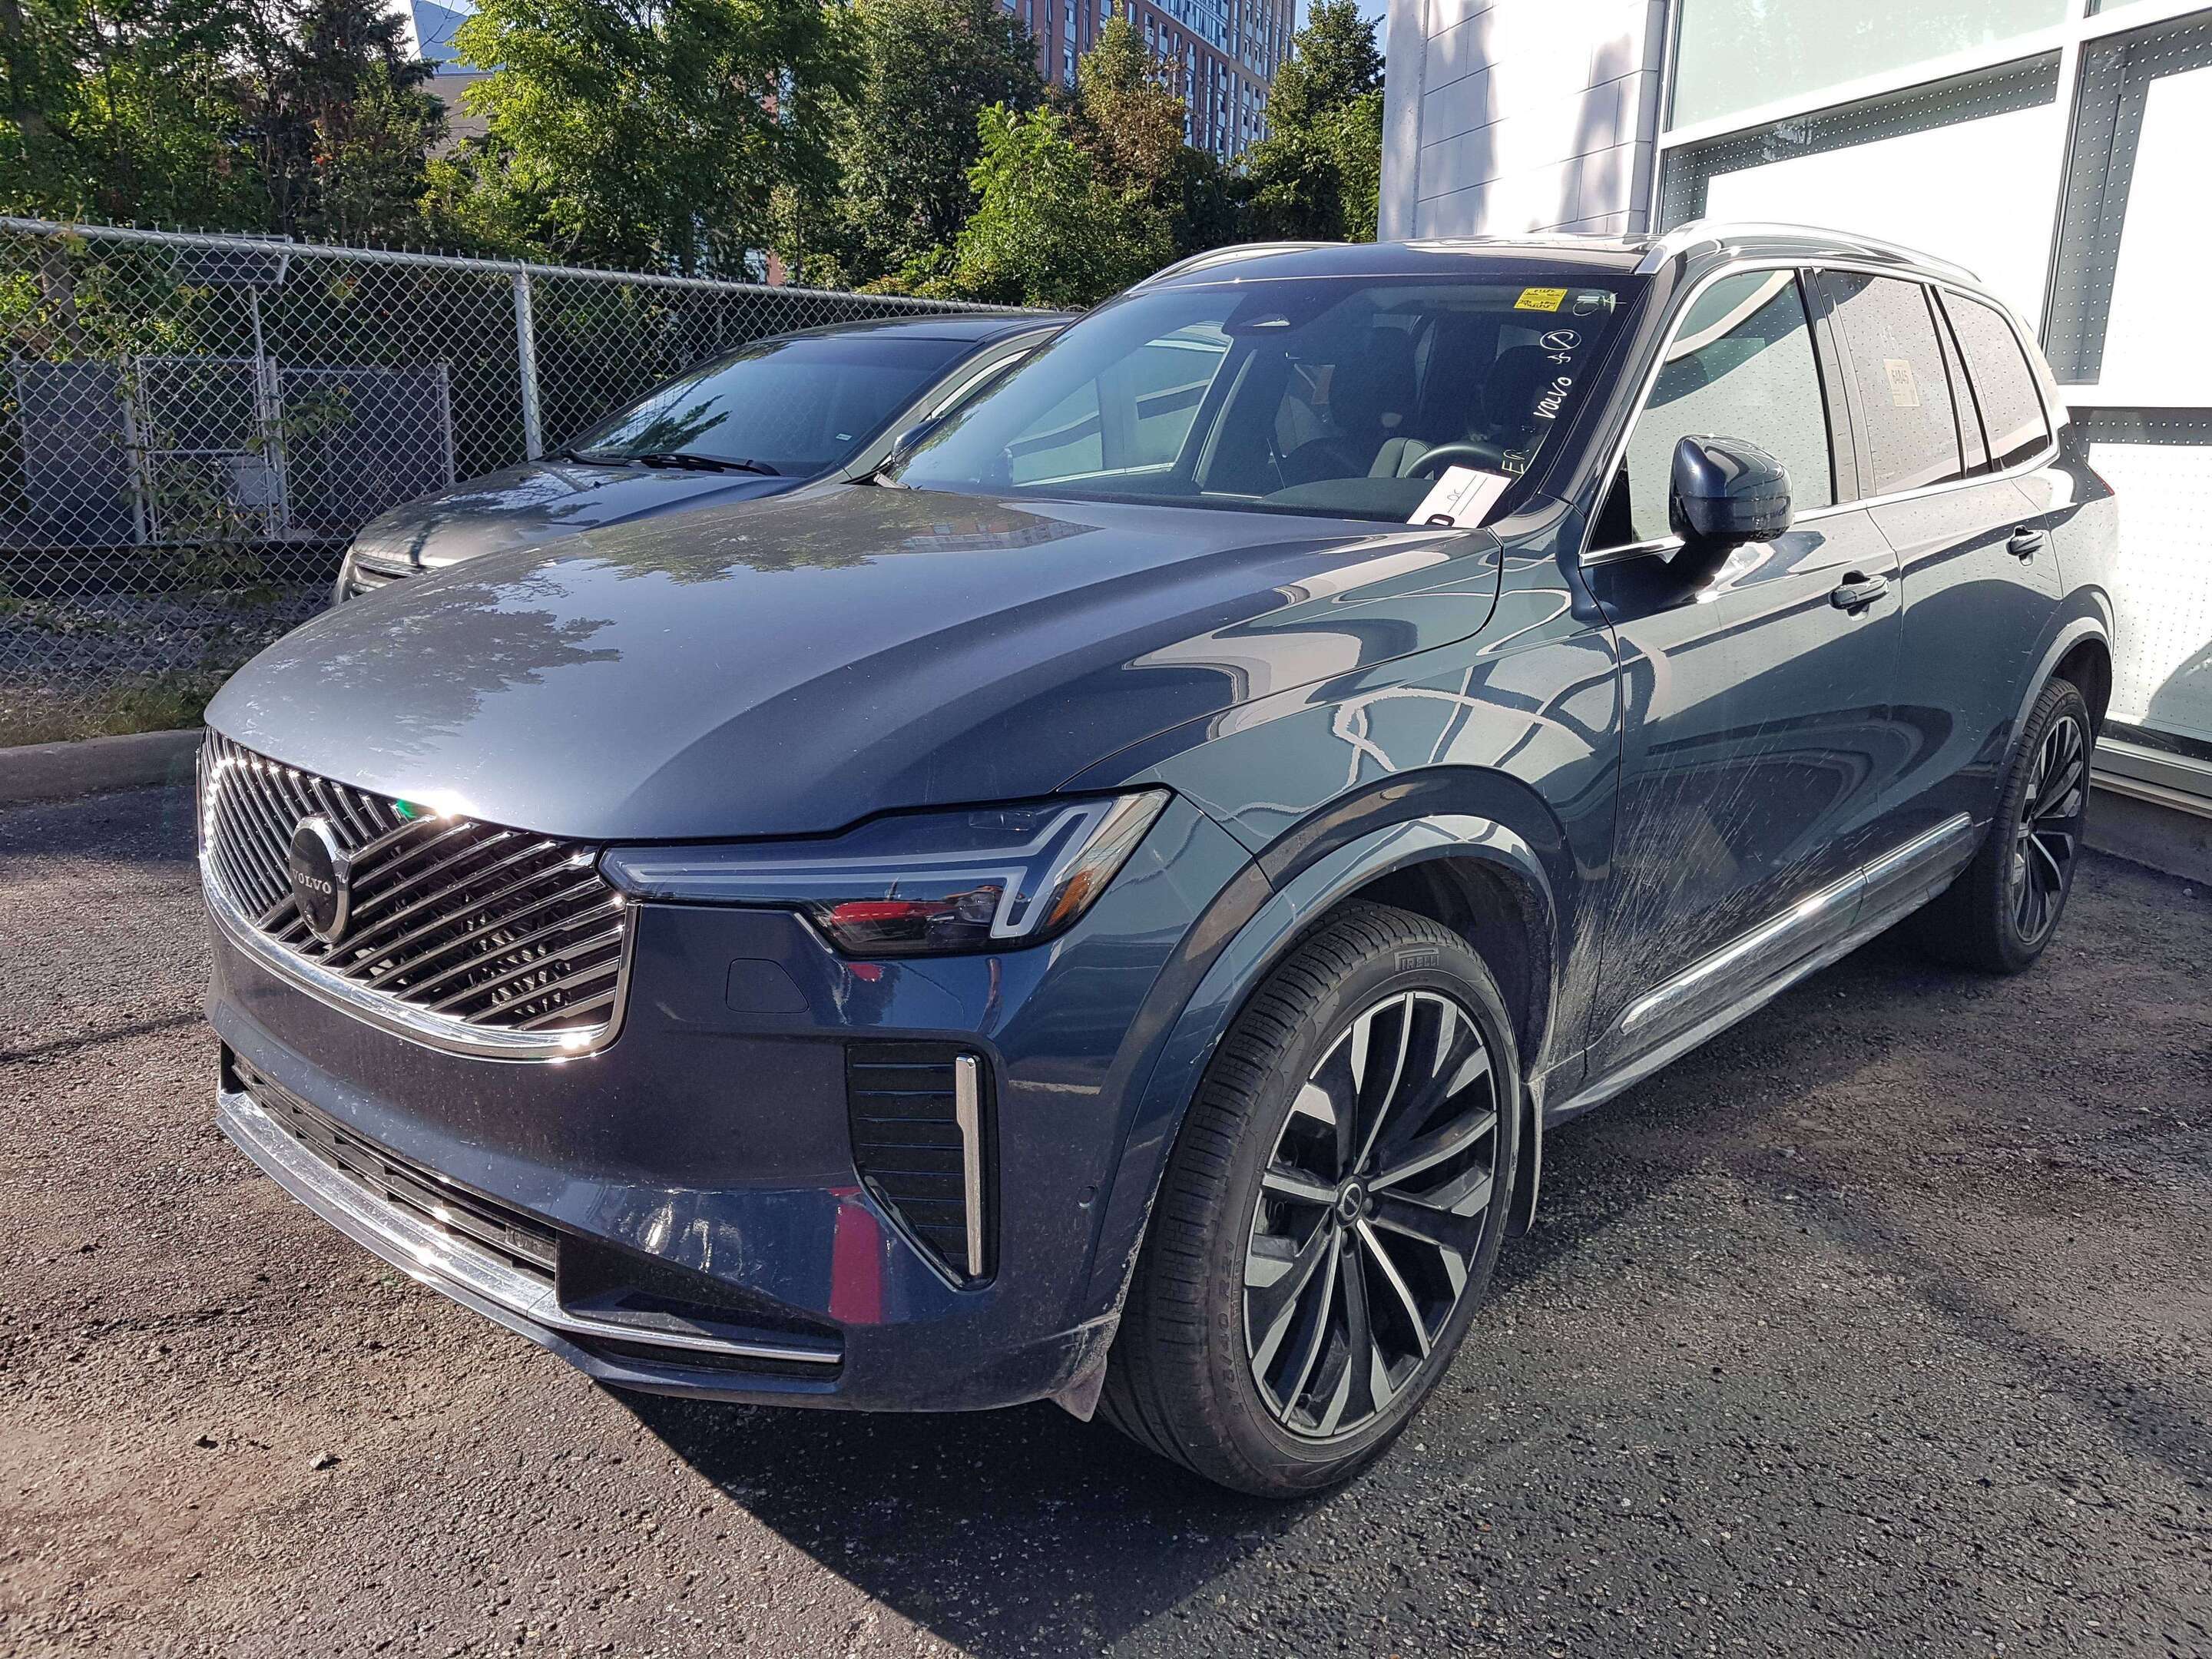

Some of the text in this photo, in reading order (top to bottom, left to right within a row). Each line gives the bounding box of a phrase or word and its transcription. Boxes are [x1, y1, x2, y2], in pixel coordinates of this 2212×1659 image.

[1533, 376, 1572, 419] VOLVO
[292, 868, 332, 895] VOLVO
[1394, 948, 1439, 972] PIRELLI
